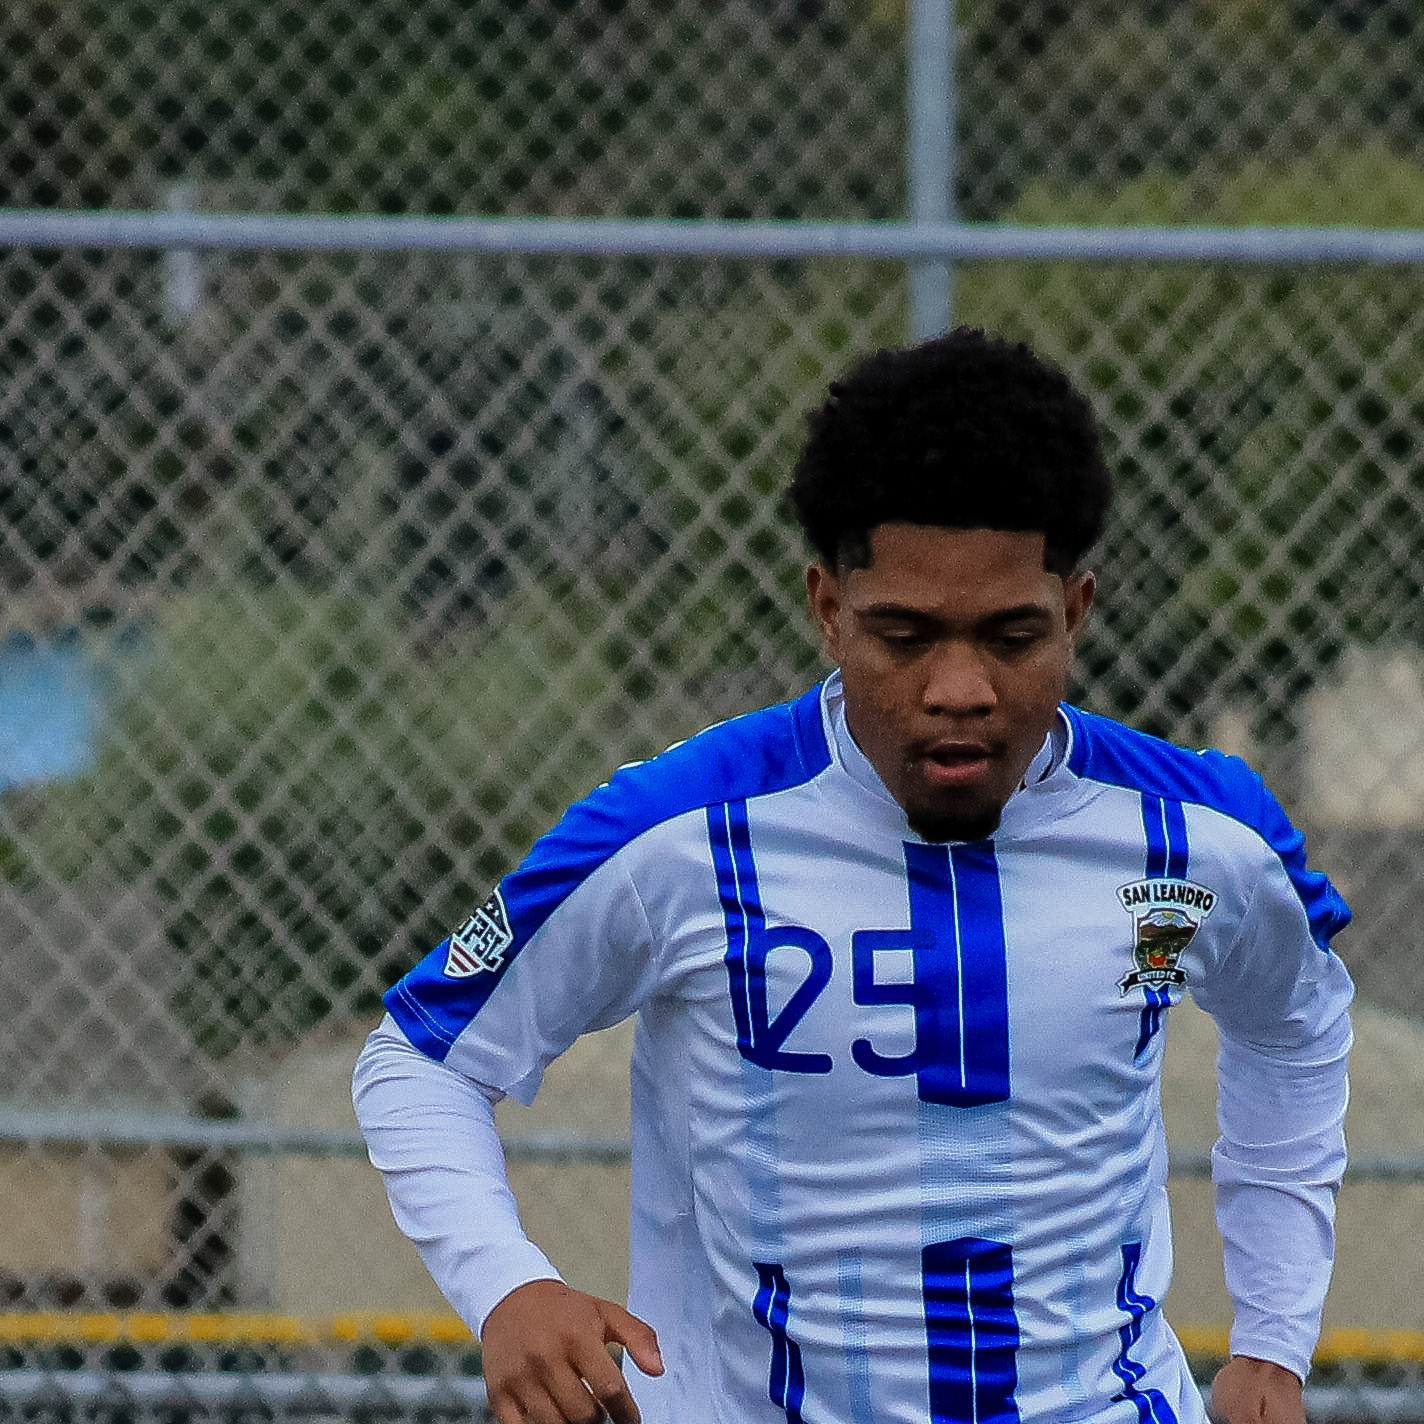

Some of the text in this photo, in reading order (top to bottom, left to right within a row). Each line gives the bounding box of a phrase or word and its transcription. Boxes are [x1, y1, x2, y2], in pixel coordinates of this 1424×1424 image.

[1122, 883, 1214, 911] SAN LEANDRO
[459, 914, 505, 972] PSL
[751, 925, 939, 1077] 25
